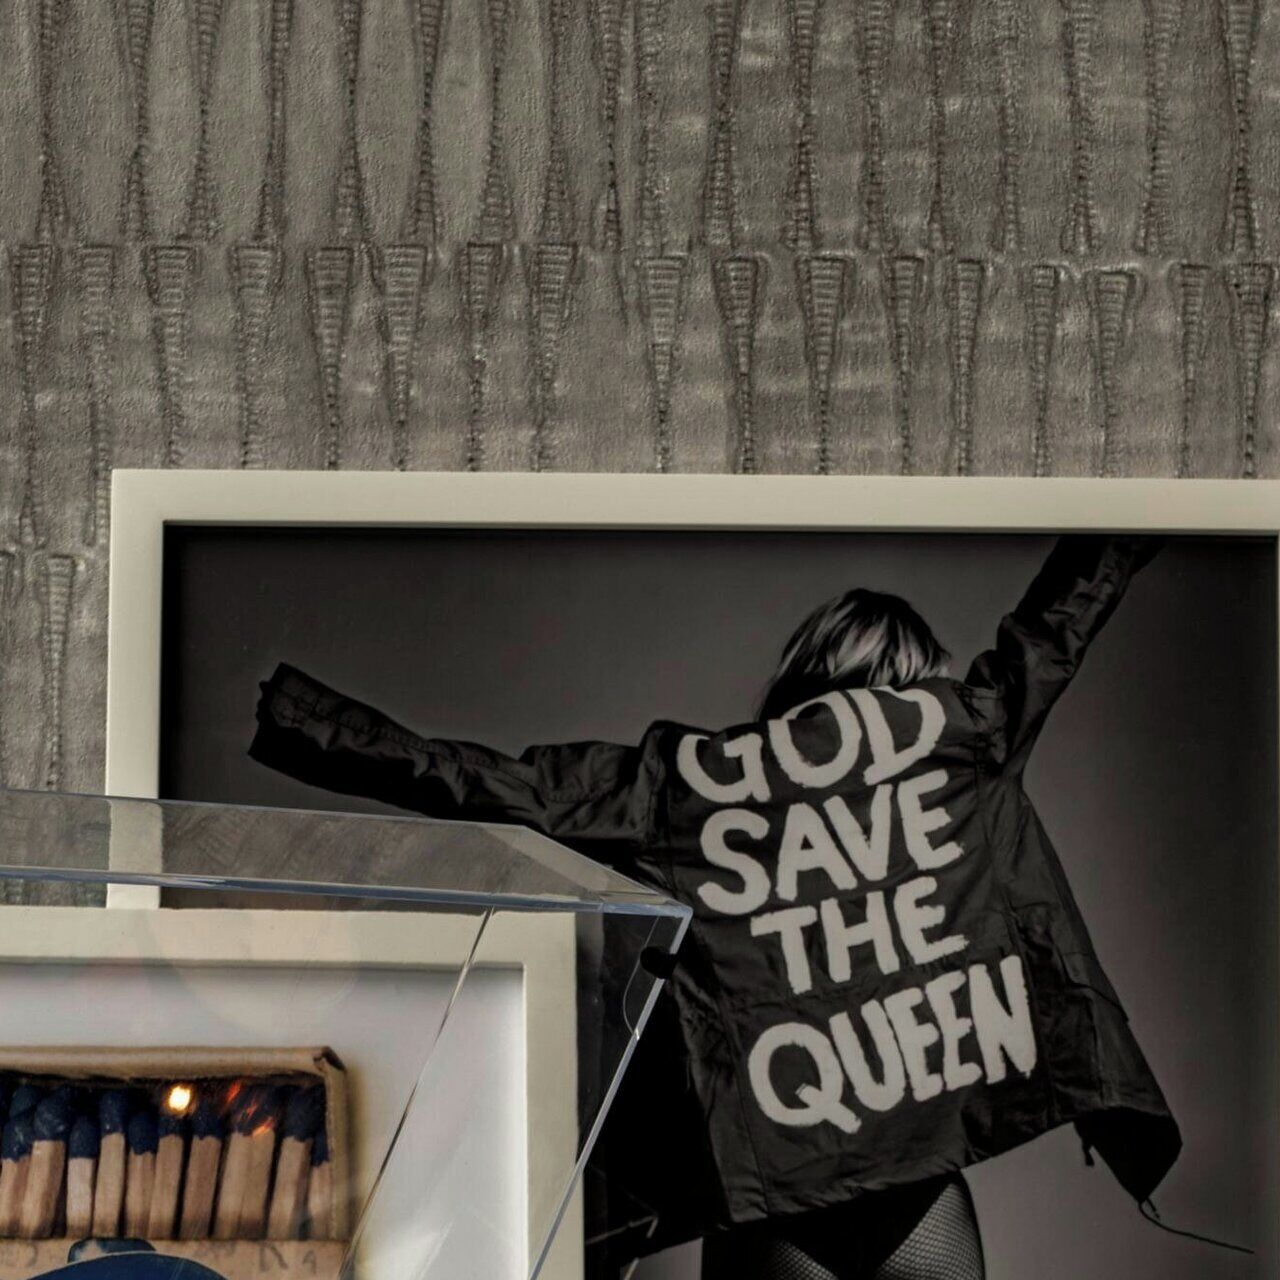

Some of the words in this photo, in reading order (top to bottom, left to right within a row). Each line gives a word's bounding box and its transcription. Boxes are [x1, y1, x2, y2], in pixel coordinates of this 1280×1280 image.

[676, 685, 947, 803] GOD
[697, 768, 965, 915] SAVE
[750, 875, 970, 995] THE
[748, 954, 1036, 1134] QUEEN
